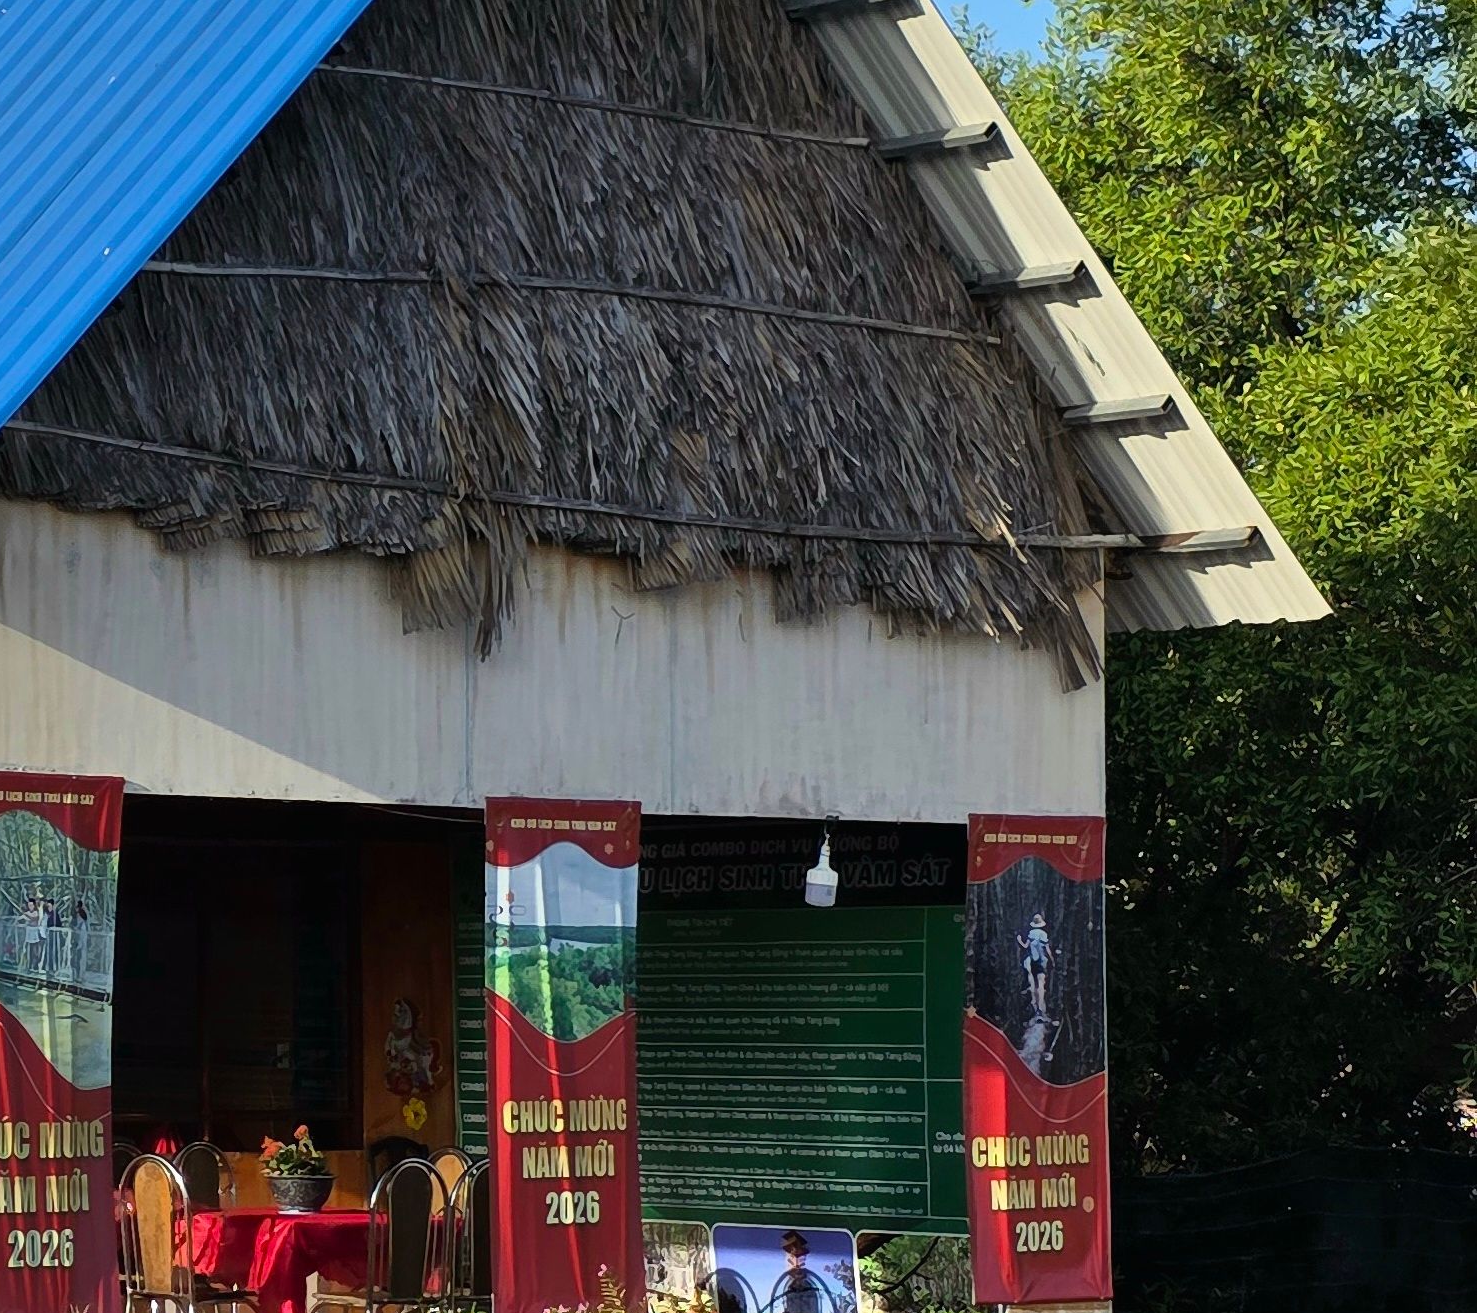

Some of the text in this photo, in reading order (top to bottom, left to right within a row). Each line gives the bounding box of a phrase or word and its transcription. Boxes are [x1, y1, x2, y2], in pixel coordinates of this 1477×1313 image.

[690, 840, 746, 857] COMBO
[658, 865, 714, 898] LỊCH
[718, 863, 775, 892] SINH
[842, 854, 897, 889] VÀM
[901, 852, 952, 888] SÁT
[502, 1094, 627, 1134] CHÚC MỪNG
[39, 1114, 105, 1159] MỪNG
[971, 1130, 1090, 1167] CHÚC MỪNG
[522, 1141, 570, 1179] NĂM
[574, 1138, 615, 1178] MỚI
[45, 1168, 90, 1213] MỚI
[545, 1190, 600, 1225] 2026
[990, 1172, 1077, 1211] NĂM MỚI
[7, 1228, 74, 1268] 2026
[1015, 1220, 1064, 1253] 2026
